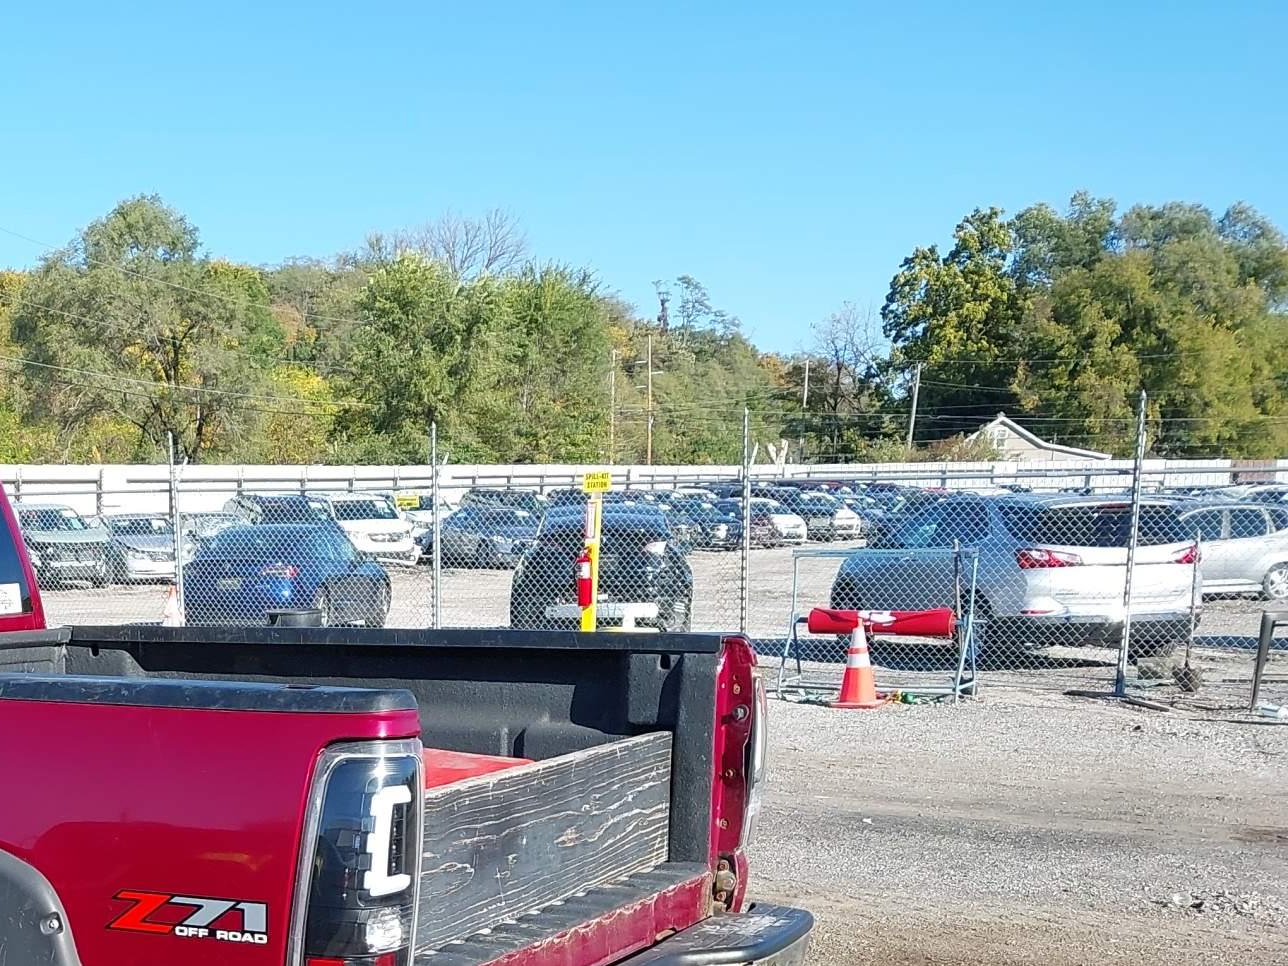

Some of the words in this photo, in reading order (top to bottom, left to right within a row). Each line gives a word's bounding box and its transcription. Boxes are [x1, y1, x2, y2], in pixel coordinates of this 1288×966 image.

[107, 890, 268, 934] Z71
[174, 926, 209, 938] OFF
[216, 930, 268, 944] ROAD
